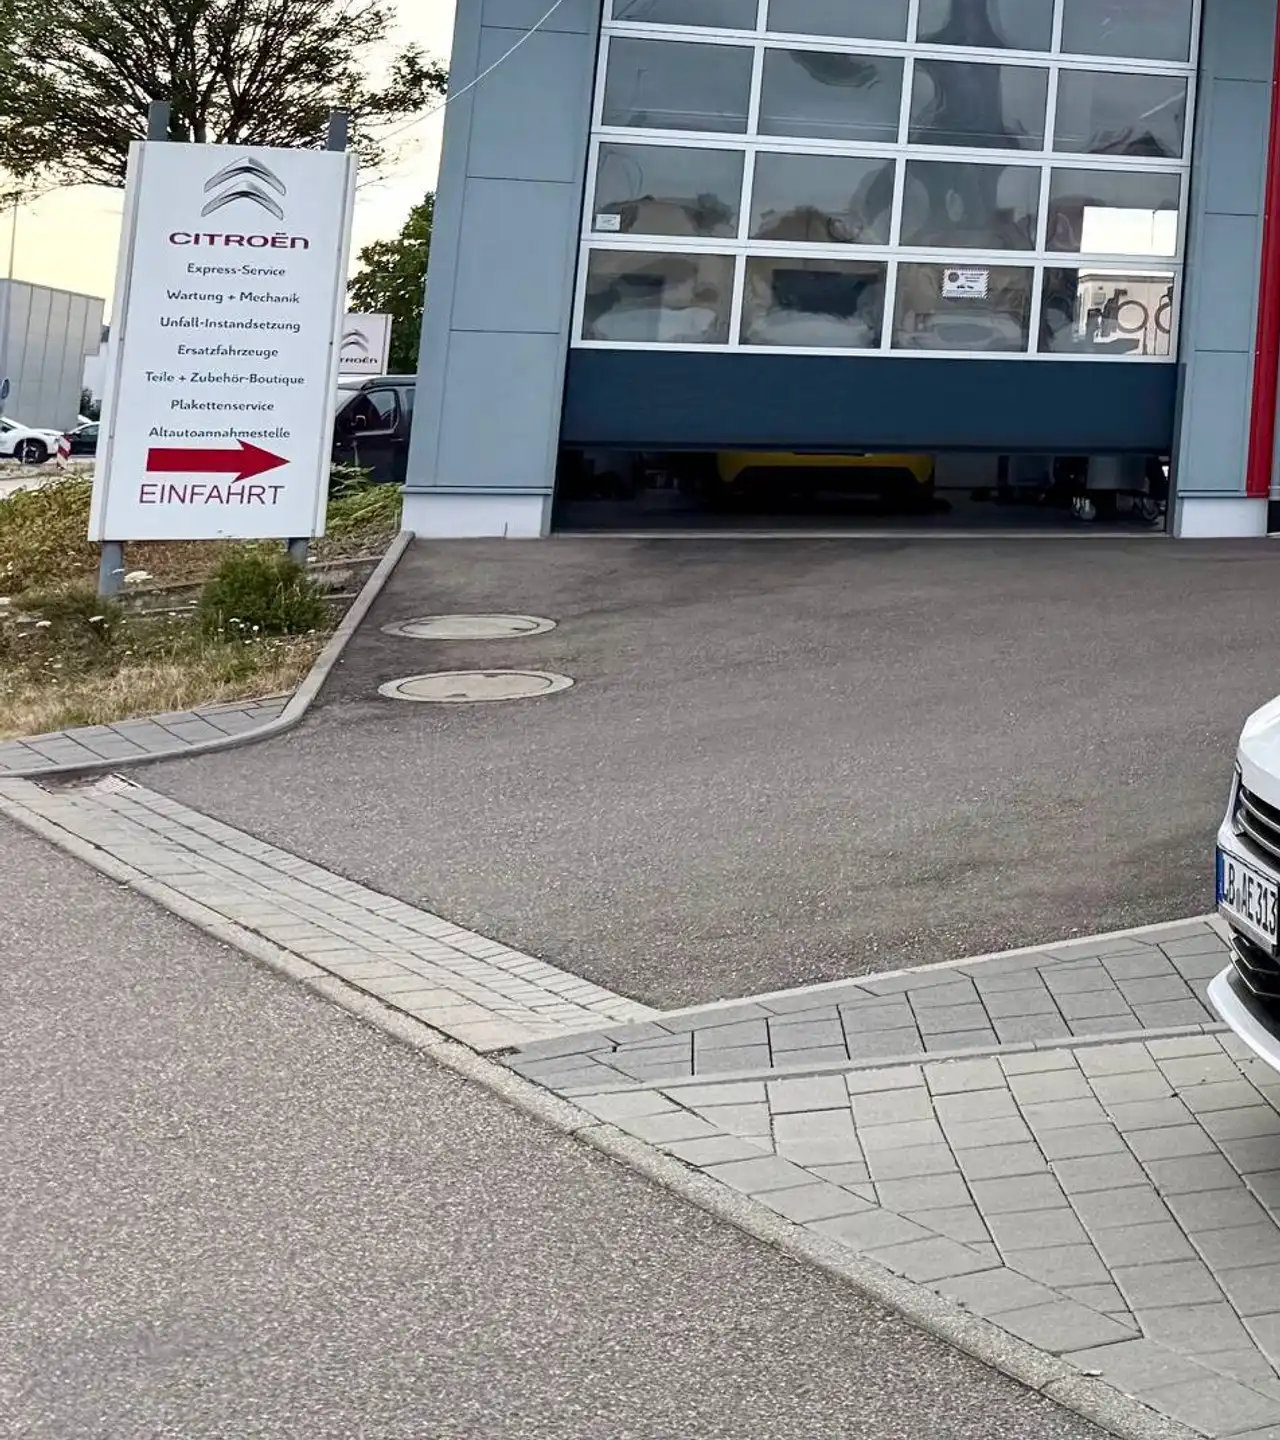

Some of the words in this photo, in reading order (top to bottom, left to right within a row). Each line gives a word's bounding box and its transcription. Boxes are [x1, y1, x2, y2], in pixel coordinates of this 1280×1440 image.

[169, 232, 310, 250] CITROËN
[187, 263, 286, 277] Express-Service
[166, 289, 223, 304] Wartung
[239, 291, 301, 304] Mechanik
[160, 316, 301, 333] Unfall-Instandsetzung
[177, 344, 279, 359] Ersatzfahrzeuge
[145, 371, 175, 382] Teile
[190, 372, 305, 387] Zubehör-Boutique
[170, 399, 275, 411] Plakettenservice
[148, 426, 291, 438] Altautoannahmestelle
[139, 483, 285, 505] EINFAHRT
